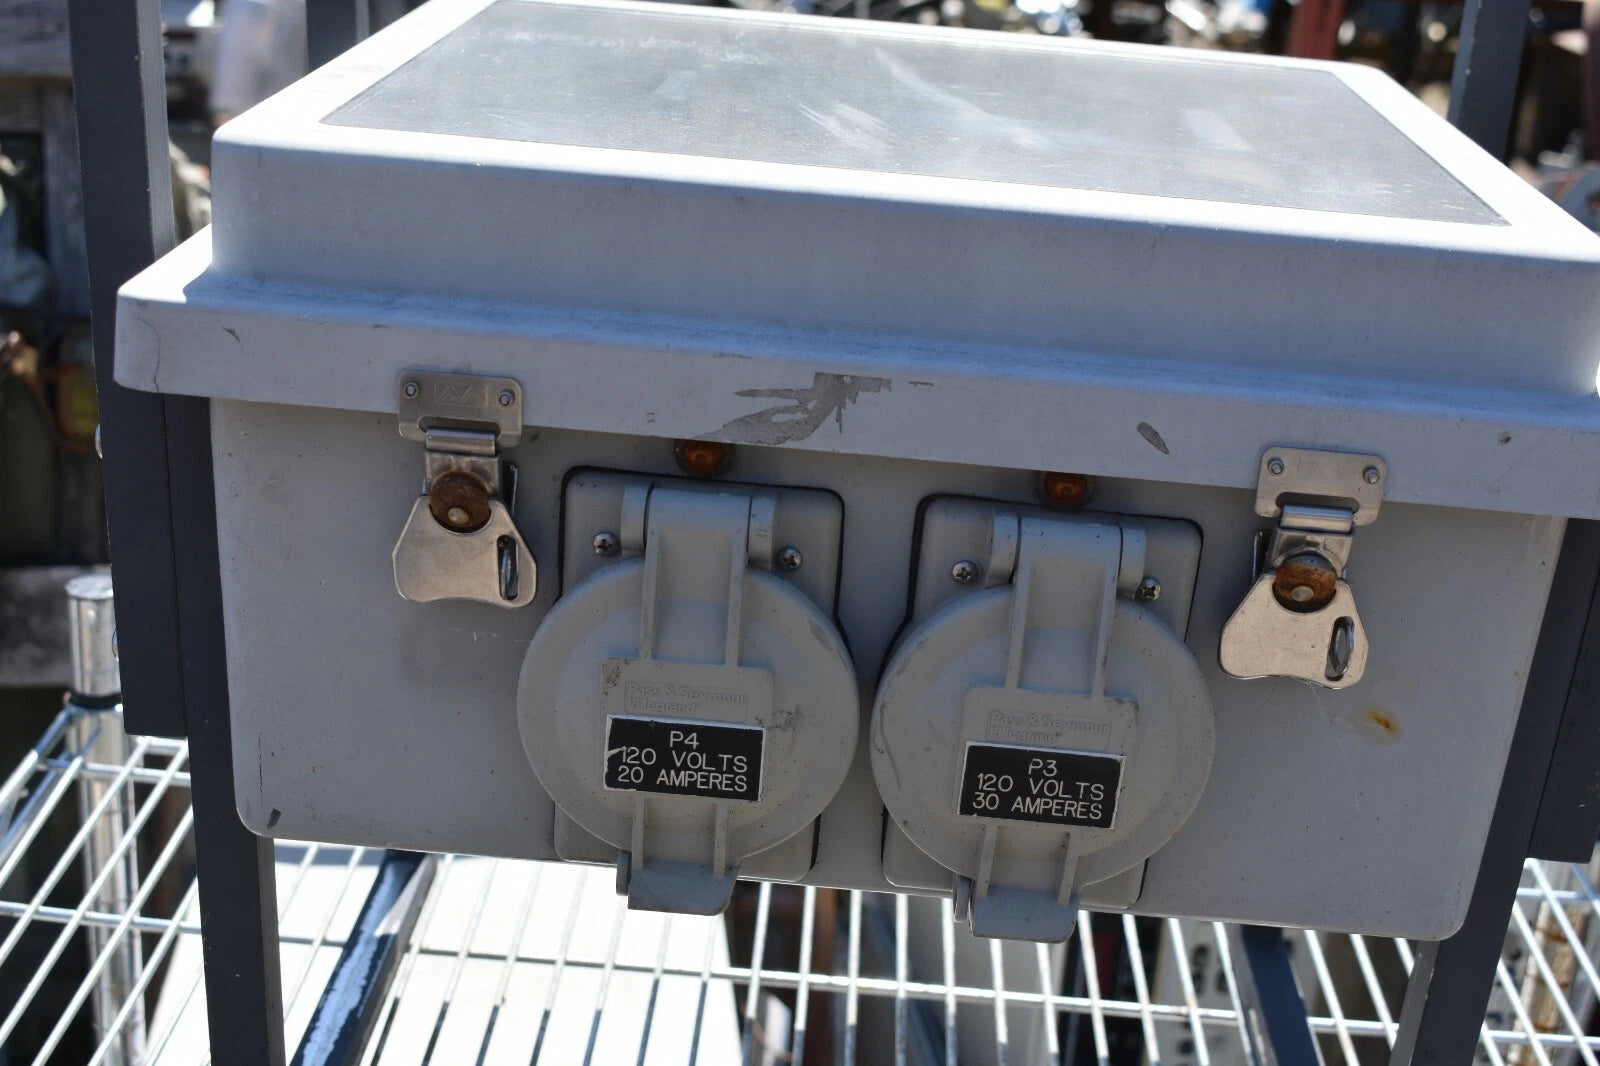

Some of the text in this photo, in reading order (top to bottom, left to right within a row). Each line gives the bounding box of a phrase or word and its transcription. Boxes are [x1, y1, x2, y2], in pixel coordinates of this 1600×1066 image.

[669, 730, 699, 749] P4
[620, 745, 748, 772] 120 VOLTS
[1028, 758, 1058, 777] P3
[617, 766, 747, 792] 20 AMPERES
[977, 773, 1104, 801] 120 VOLTS
[972, 791, 1102, 820] 30 AMPERES
